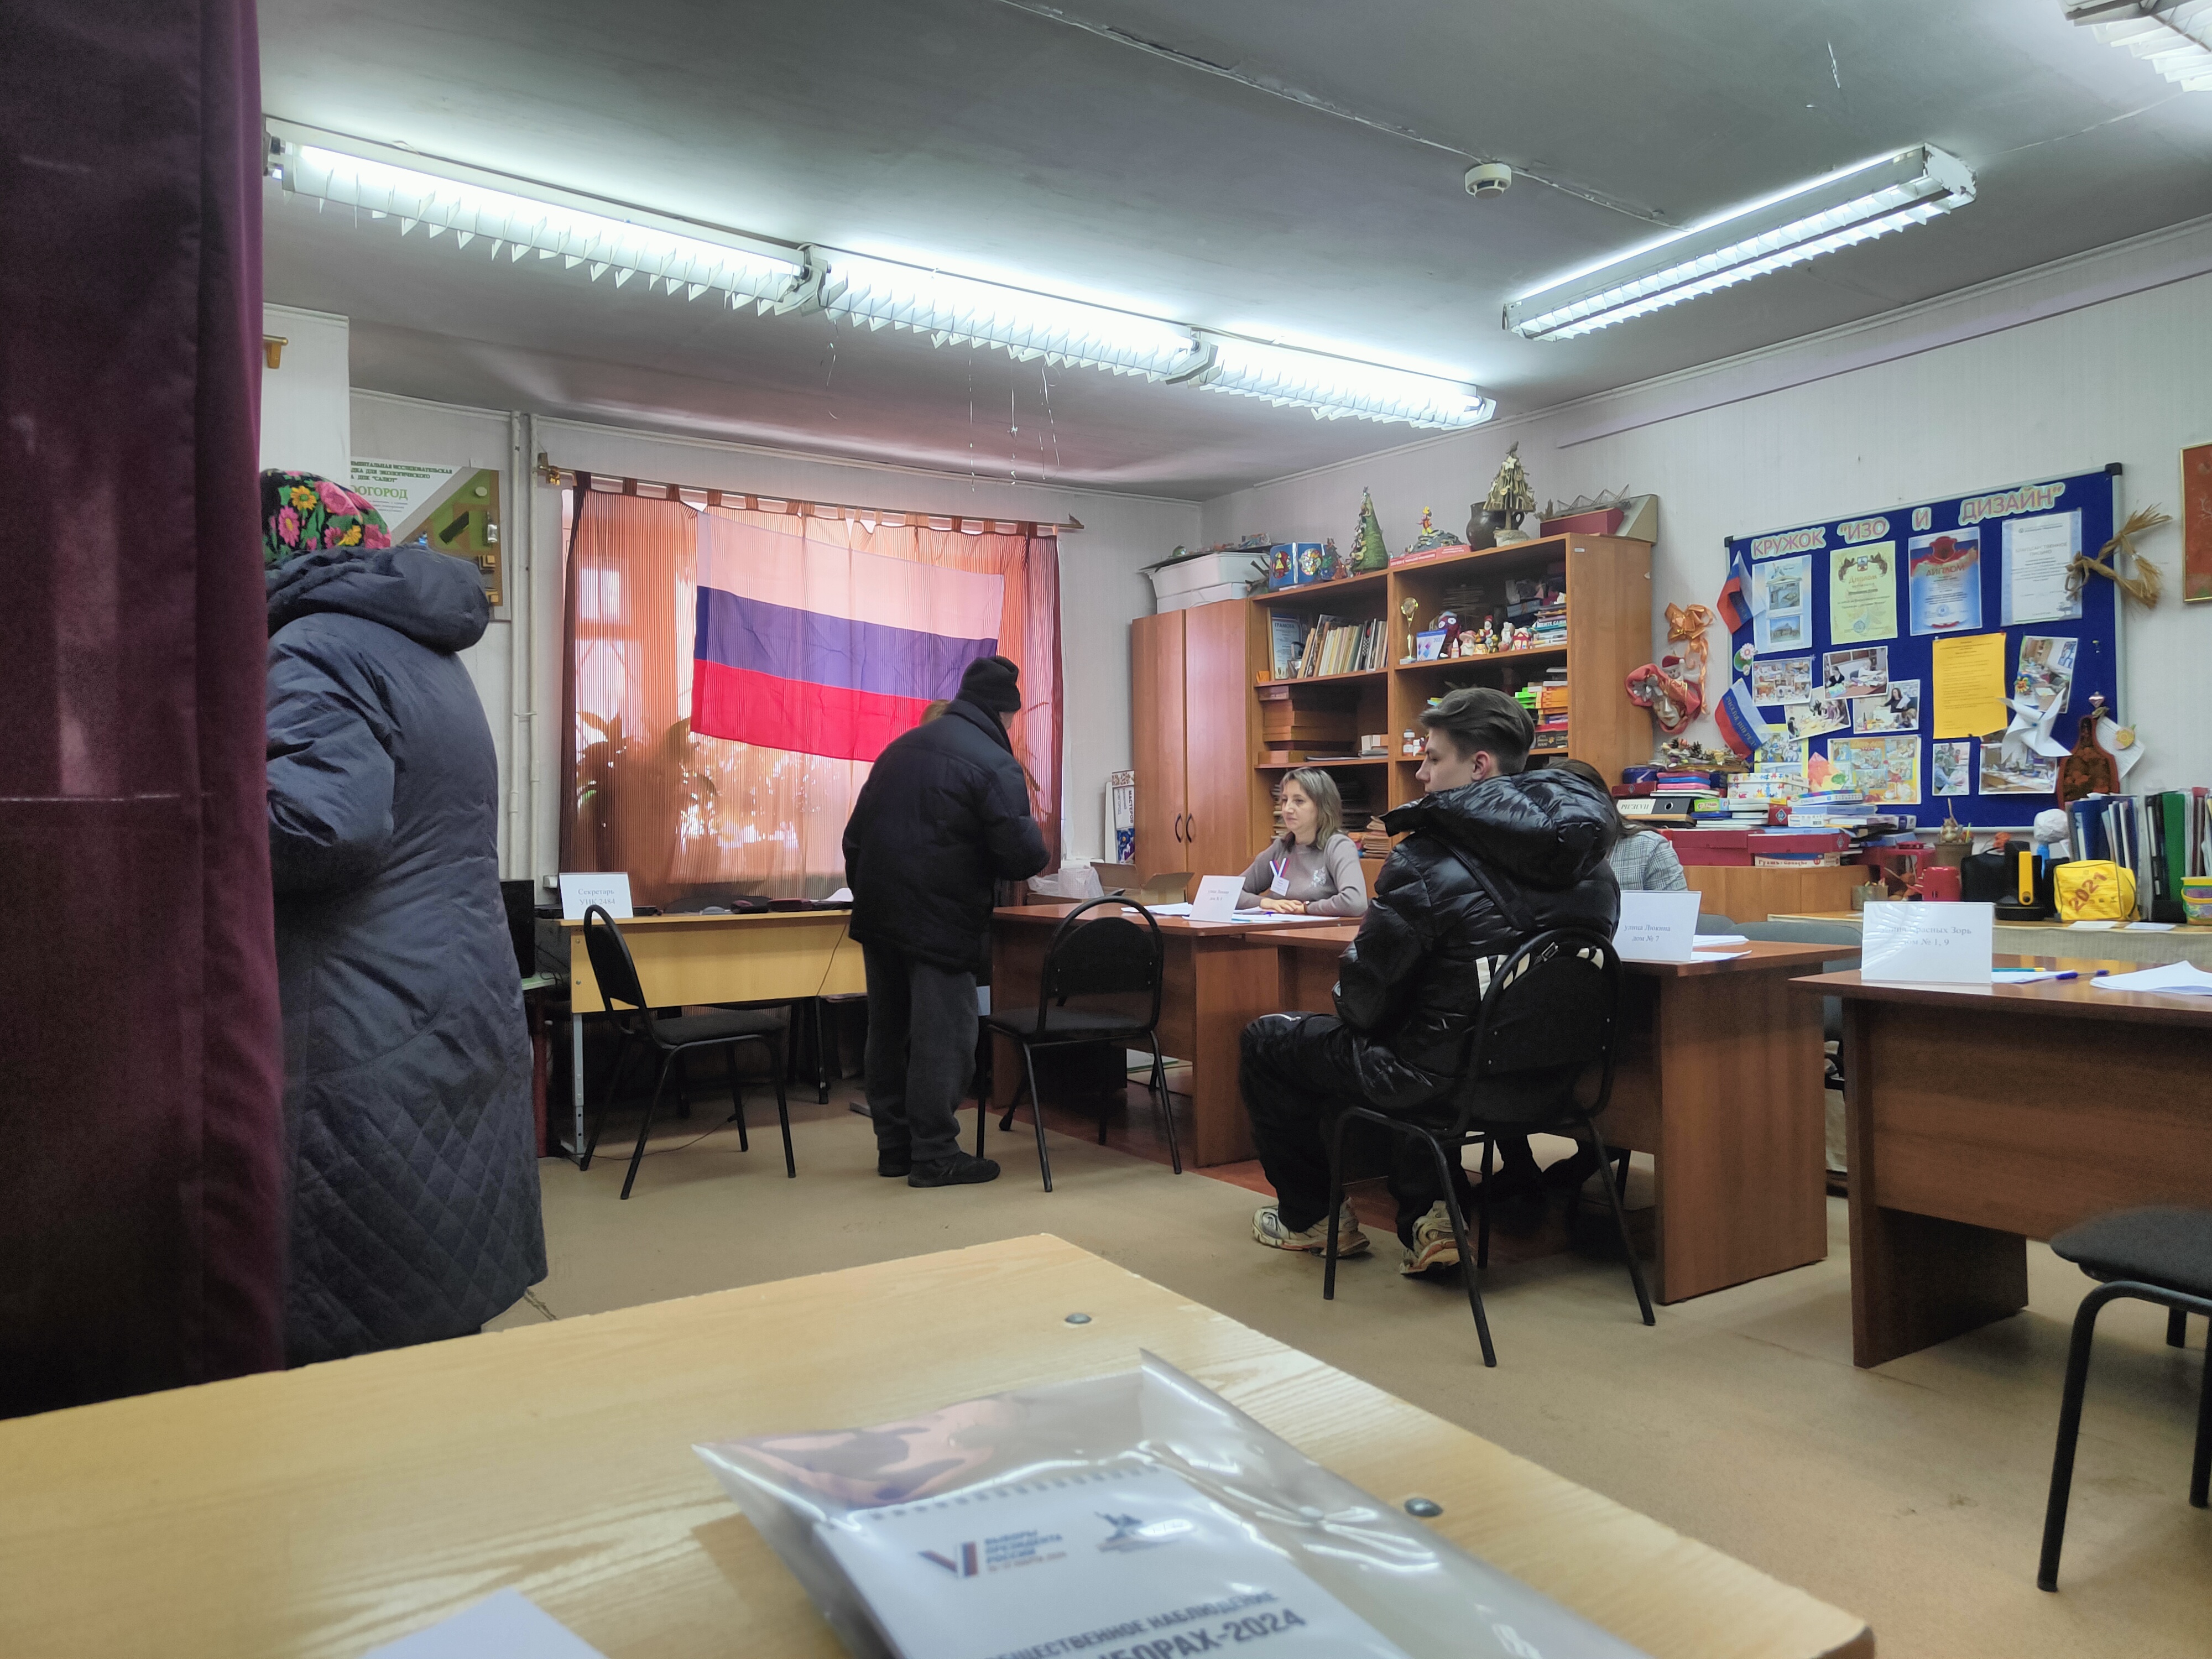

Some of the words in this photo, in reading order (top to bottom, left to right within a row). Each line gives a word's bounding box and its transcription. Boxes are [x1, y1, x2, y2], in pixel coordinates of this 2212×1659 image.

[1752, 529, 1824, 556] КРУЖОК
[1840, 519, 1887, 541] "ИЗО
[1915, 509, 1928, 527] И
[1961, 486, 2064, 522] ДИЗАЙН"
[2015, 541, 2067, 553] БЛАГОДАРТВЕННОЕ
[1926, 564, 1964, 576] ДИПЛОМ
[578, 888, 614, 896] Секретарь
[2068, 872, 2107, 912] 2021
[1911, 926, 1948, 935] расных
[1951, 926, 1972, 935] Зорь
[1921, 938, 1931, 946] №
[986, 1619, 1149, 1659] ЩЕСТВЕННОЕ
[1147, 1591, 1280, 1629] НАБЛЮДЕНИЕ
[1099, 1608, 1307, 1659] ОРАХ-2024
